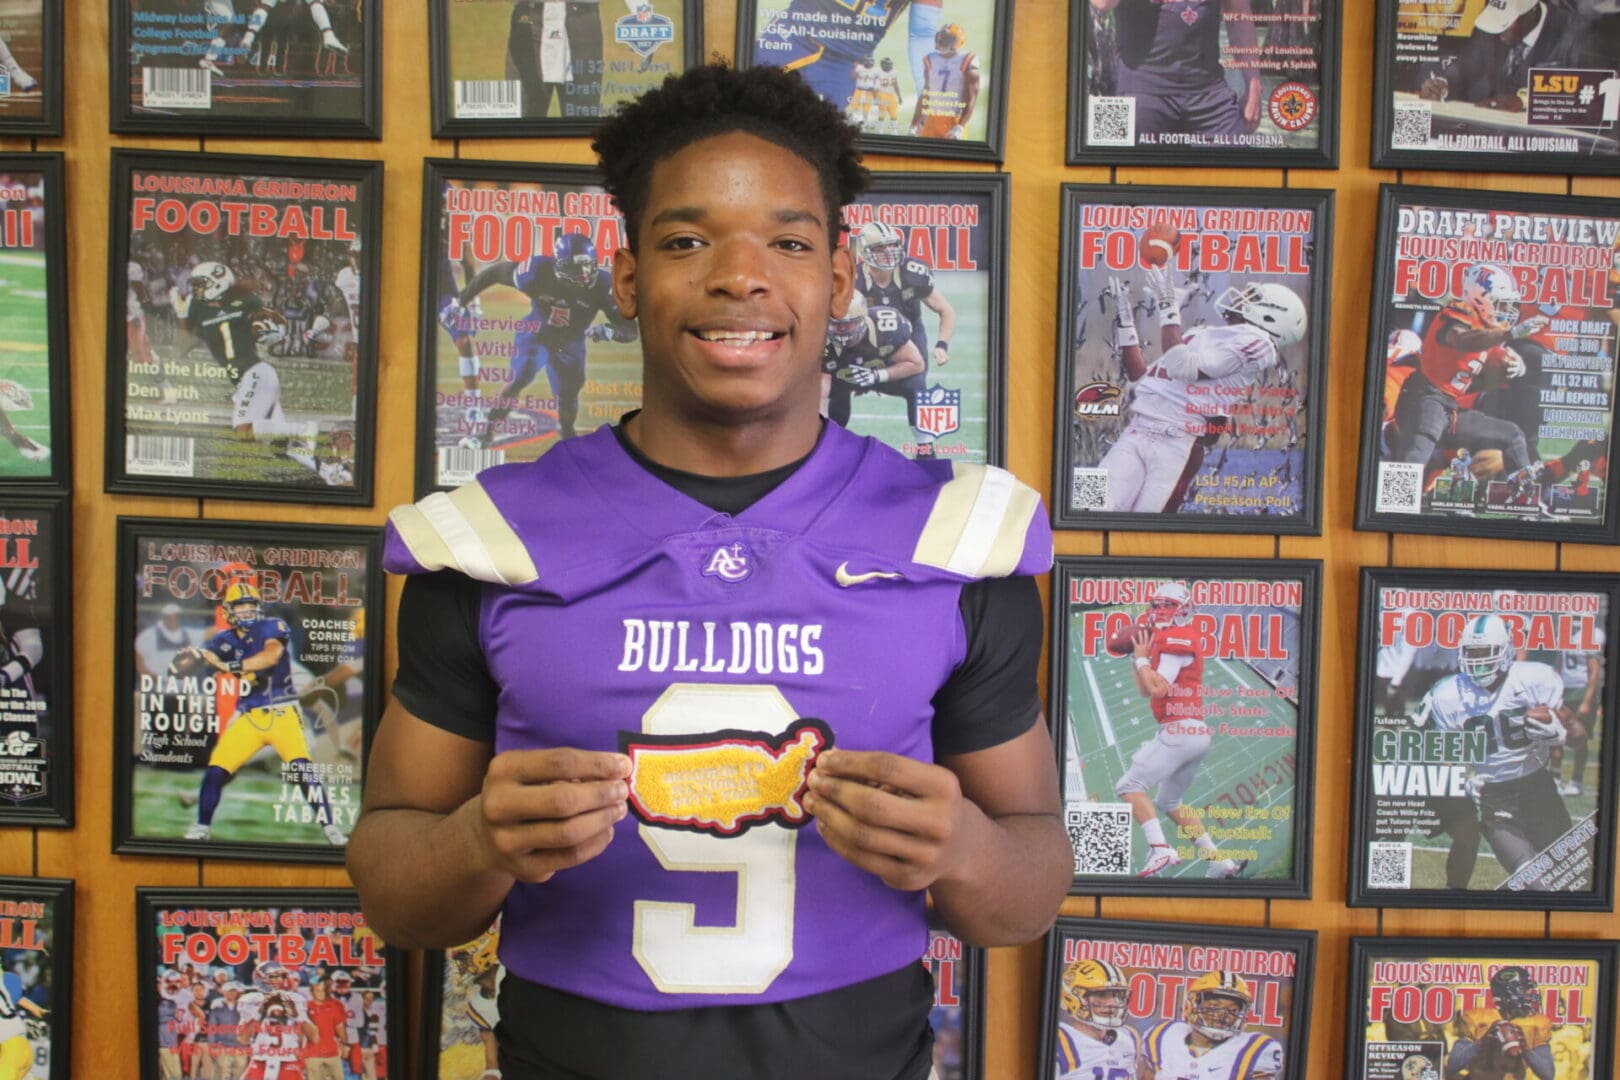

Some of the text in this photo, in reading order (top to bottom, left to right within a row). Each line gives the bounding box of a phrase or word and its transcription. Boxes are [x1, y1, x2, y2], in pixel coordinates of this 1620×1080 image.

[760, 8, 887, 26] Who made the 2016
[1223, 13, 1317, 21] NFC Preseason Preview
[133, 27, 173, 39] College
[620, 27, 669, 38] DRAFT
[758, 38, 792, 51] Team
[1222, 46, 1313, 55] University of Louisiana
[1251, 61, 1281, 70] Making
[1290, 61, 1317, 70] Splash
[1533, 74, 1579, 93] LSU
[1579, 78, 1620, 121] #1
[1289, 101, 1314, 128] CAJUNS
[1139, 133, 1285, 146] ALL ALL LOUISIANA
[1438, 134, 1579, 152] ALL ALL LOUISIANA
[132, 174, 357, 201] LOUISIANA GRIDIRON
[446, 188, 624, 217] LOUISIANA GRID
[132, 198, 357, 241] FOOTBALL
[879, 203, 979, 226] GRIDIRON
[1083, 205, 1312, 233] LOUISIANA GRIDIRON
[1397, 208, 1620, 245] DRAFT PREVIEW
[1399, 235, 1614, 269] LOUISIANA GRIDIRON
[454, 316, 541, 333] Interview
[1550, 319, 1612, 335] MOCK DRAFT
[475, 341, 519, 358] With
[128, 360, 239, 379] Into the Lion's
[478, 367, 515, 384] NSU
[1185, 383, 1253, 396] Can Coach
[1551, 374, 1598, 388] ALL 32 NFL
[128, 383, 200, 399] Den with
[1540, 389, 1608, 405] TEAM REPORTS
[435, 391, 558, 411] Defensive End
[1078, 403, 1119, 416] ULM
[127, 406, 209, 424] Max Lyons
[918, 406, 956, 432] NFL
[456, 420, 537, 436] Lyn Clark
[1184, 422, 1233, 435] Sunbelt
[903, 443, 967, 455] First Look
[1195, 475, 1278, 487] LSU #5 in AP
[1195, 494, 1291, 507] Preseason Poll
[147, 542, 359, 569] LOUISIANA GRIDIRON
[1192, 581, 1303, 607] GRIDIRON
[1383, 590, 1600, 613] LOUISIANA GRIDIRON
[302, 618, 356, 630] COACHES
[308, 631, 356, 642] CORNER
[1082, 611, 1289, 660] FOBALL
[311, 643, 356, 652] TIPS FROM
[617, 618, 824, 675] BULLDOGS
[300, 654, 356, 664] LINDSEY COX
[141, 674, 251, 696] DIAMOND
[1167, 684, 1296, 698] The New Face Of
[141, 694, 216, 714] IN THE
[1166, 703, 1224, 716] Nicholls
[141, 712, 220, 733] ROUGH
[1166, 722, 1297, 737] Chase Fourcade
[1373, 716, 1408, 726] Tulane
[141, 732, 208, 749] High School
[1373, 729, 1487, 764] GREEN
[140, 750, 194, 764] Standouts
[281, 762, 353, 774] MCNEESE ON
[281, 772, 353, 784] THE RISE WITH
[1372, 765, 1467, 797] WAVE
[279, 783, 351, 805] JAMES
[272, 804, 357, 825] TABARY
[1271, 805, 1292, 820] Of
[1412, 818, 1441, 826] Football
[632, 682, 801, 994] 9
[1507, 819, 1599, 891] SPRING UPDATE
[162, 910, 274, 929] LOUISIANA
[162, 933, 385, 967] FOOTBALL
[1064, 937, 1297, 978] LOUISIANA GRIDIRON
[1374, 961, 1482, 985] LOUISIANA
[1368, 1044, 1422, 1052] OFFSEASON
[1368, 1052, 1406, 1060] REVIEW
